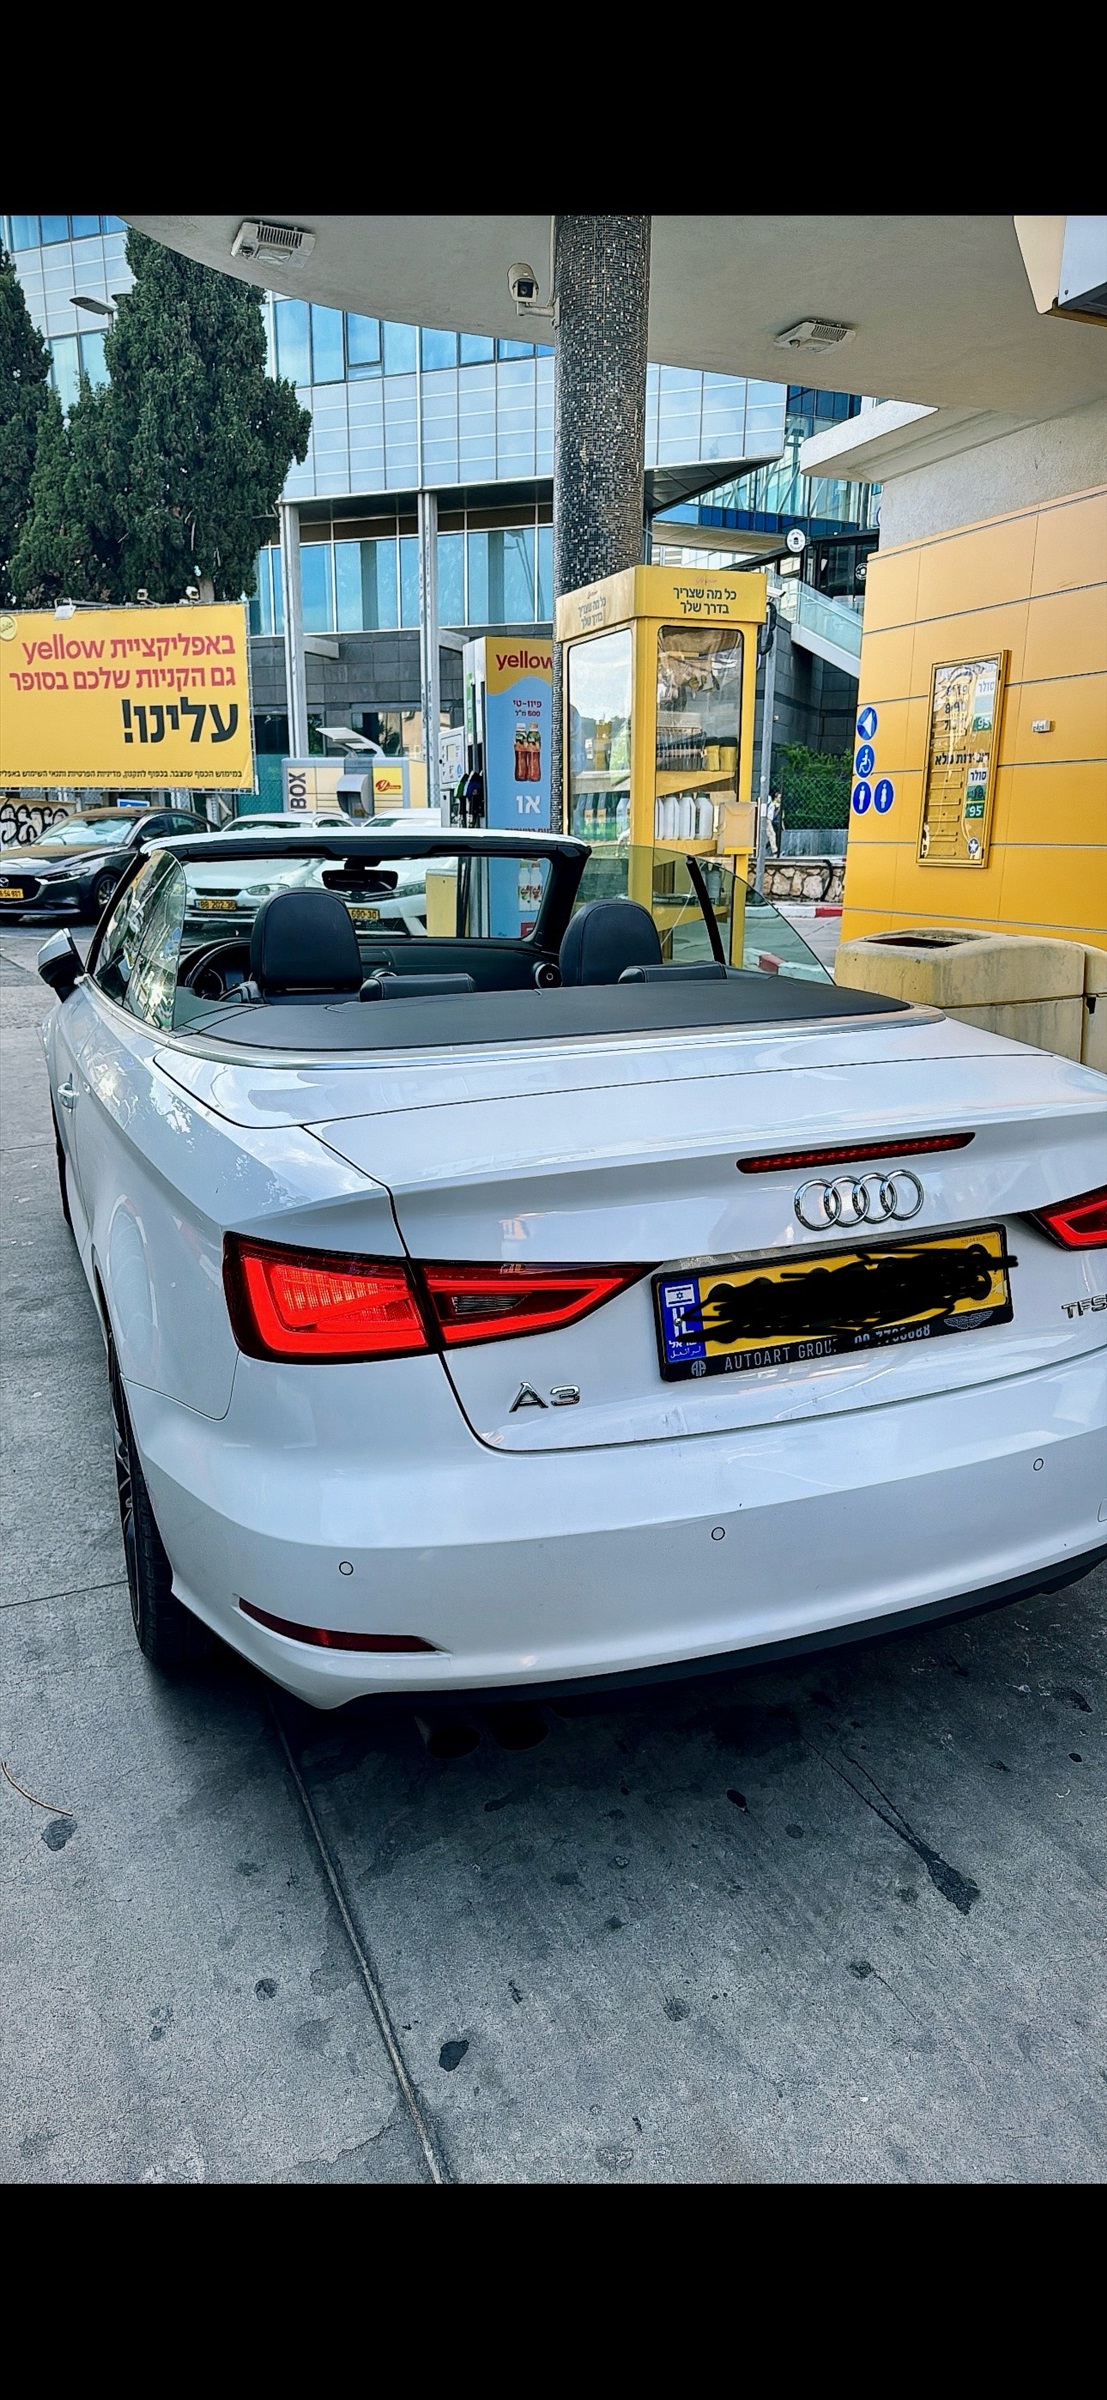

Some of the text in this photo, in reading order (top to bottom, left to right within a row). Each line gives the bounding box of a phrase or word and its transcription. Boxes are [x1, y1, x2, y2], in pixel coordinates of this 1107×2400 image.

[673, 587, 737, 600] כל מה שצריך
[680, 600, 729, 614] בדרך שלך
[21, 633, 235, 665] באפליקציית yellow
[9, 666, 236, 692] גם הקניות שלכם בסופר
[122, 696, 238, 743] עלינו!
[970, 770, 986, 781] סולר
[516, 795, 541, 814] או
[969, 806, 982, 817] 95
[724, 1346, 790, 1371] AUTOART
[509, 1382, 580, 1413] A3
